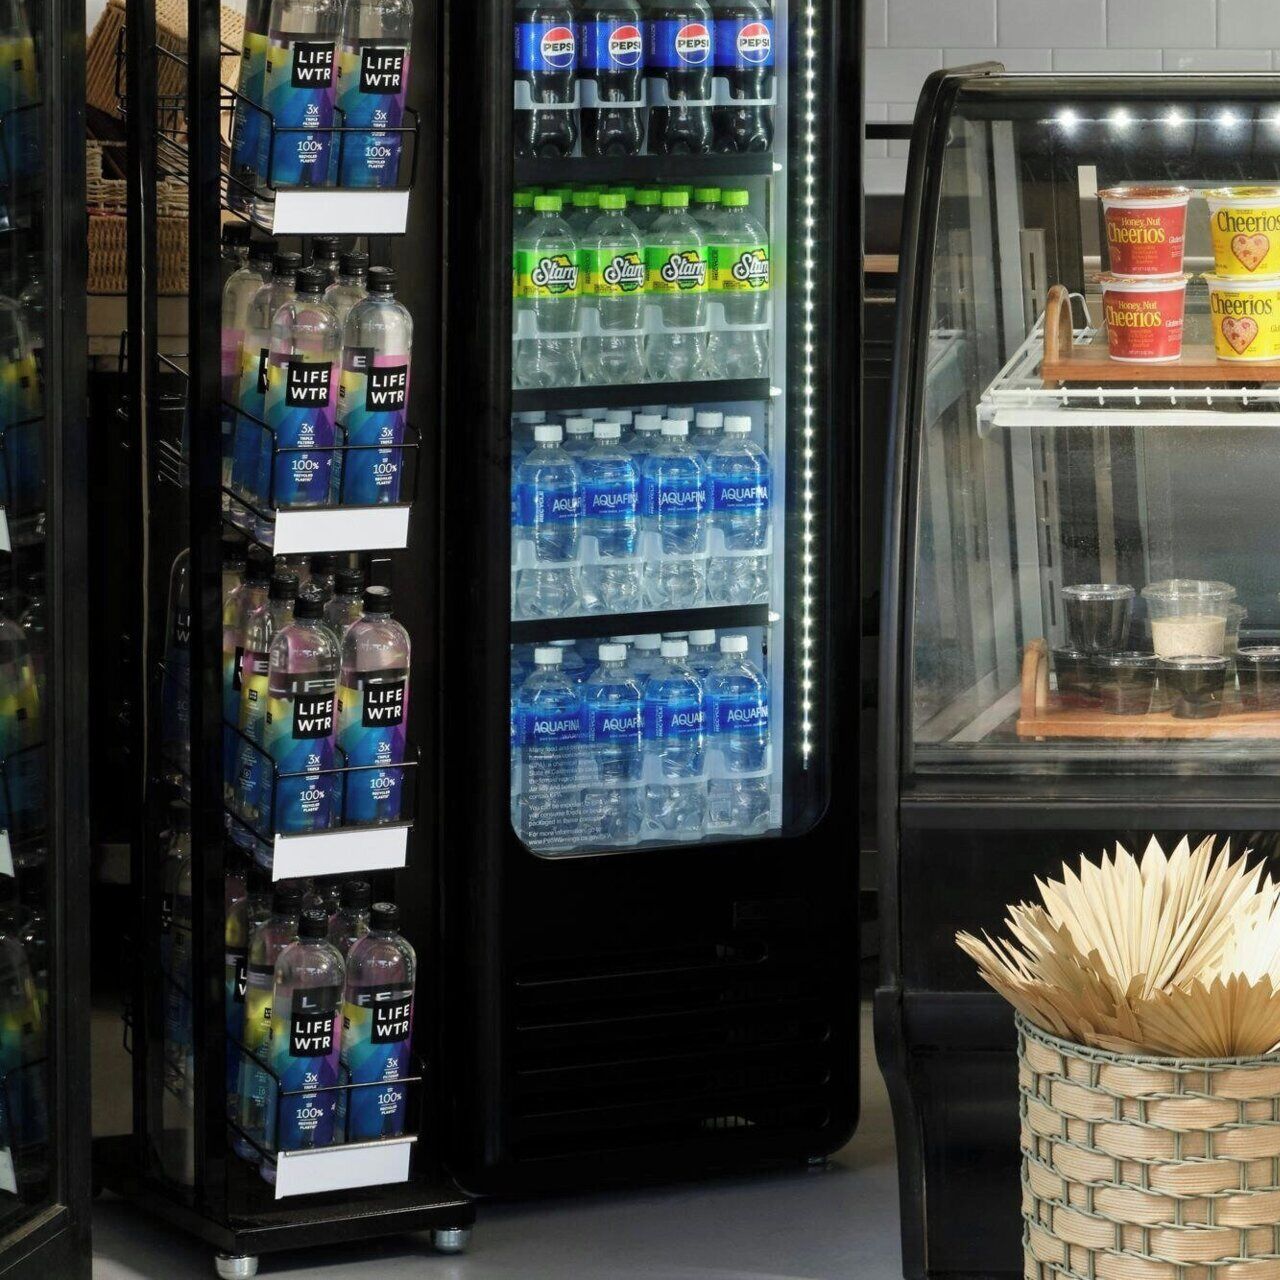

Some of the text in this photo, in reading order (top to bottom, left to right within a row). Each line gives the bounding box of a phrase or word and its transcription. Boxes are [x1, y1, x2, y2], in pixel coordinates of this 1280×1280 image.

[544, 41, 575, 52] PEPSI
[677, 39, 709, 49] PEPSI
[739, 37, 769, 48] PEPSI
[298, 51, 332, 64] LIFE
[367, 57, 402, 70] LIFE
[297, 67, 330, 80] WTR
[365, 74, 400, 87] WTR
[306, 104, 318, 114] 3x
[374, 110, 387, 120] 3x
[297, 141, 322, 152] 100%
[365, 147, 391, 157] 100%
[1121, 217, 1161, 228] Honey Nut
[1108, 222, 1165, 244] Cheerios
[532, 258, 578, 289] Starry
[1118, 300, 1157, 311] Honey Nut
[1211, 292, 1272, 315] Cheerios
[1106, 305, 1162, 327] Cheerios
[292, 370, 328, 383] LIFE
[372, 373, 406, 388] LIFE
[291, 386, 327, 400] WTR
[371, 390, 405, 404] WTR
[301, 423, 314, 433] 3x
[381, 428, 393, 438] 3x
[292, 460, 319, 471] 100%
[373, 464, 397, 474] 100%
[721, 486, 767, 502] AQUAFINA
[177, 613, 191, 627] LI
[369, 688, 402, 703] LIFE
[299, 700, 333, 715] LIFE
[367, 706, 401, 720] WTR
[298, 717, 331, 731] WTR
[378, 742, 390, 752] 3x
[308, 754, 320, 764] 3x
[370, 778, 395, 789] 100%
[300, 790, 325, 801] 100%
[378, 1004, 410, 1020] LIFE
[296, 1020, 332, 1034] LIFE
[376, 1021, 409, 1037] WTR
[295, 1036, 330, 1050] WTR
[386, 1058, 398, 1068] 3x
[305, 1073, 317, 1083] 3x
[378, 1093, 402, 1104] 100%
[296, 1108, 323, 1119] 100%
